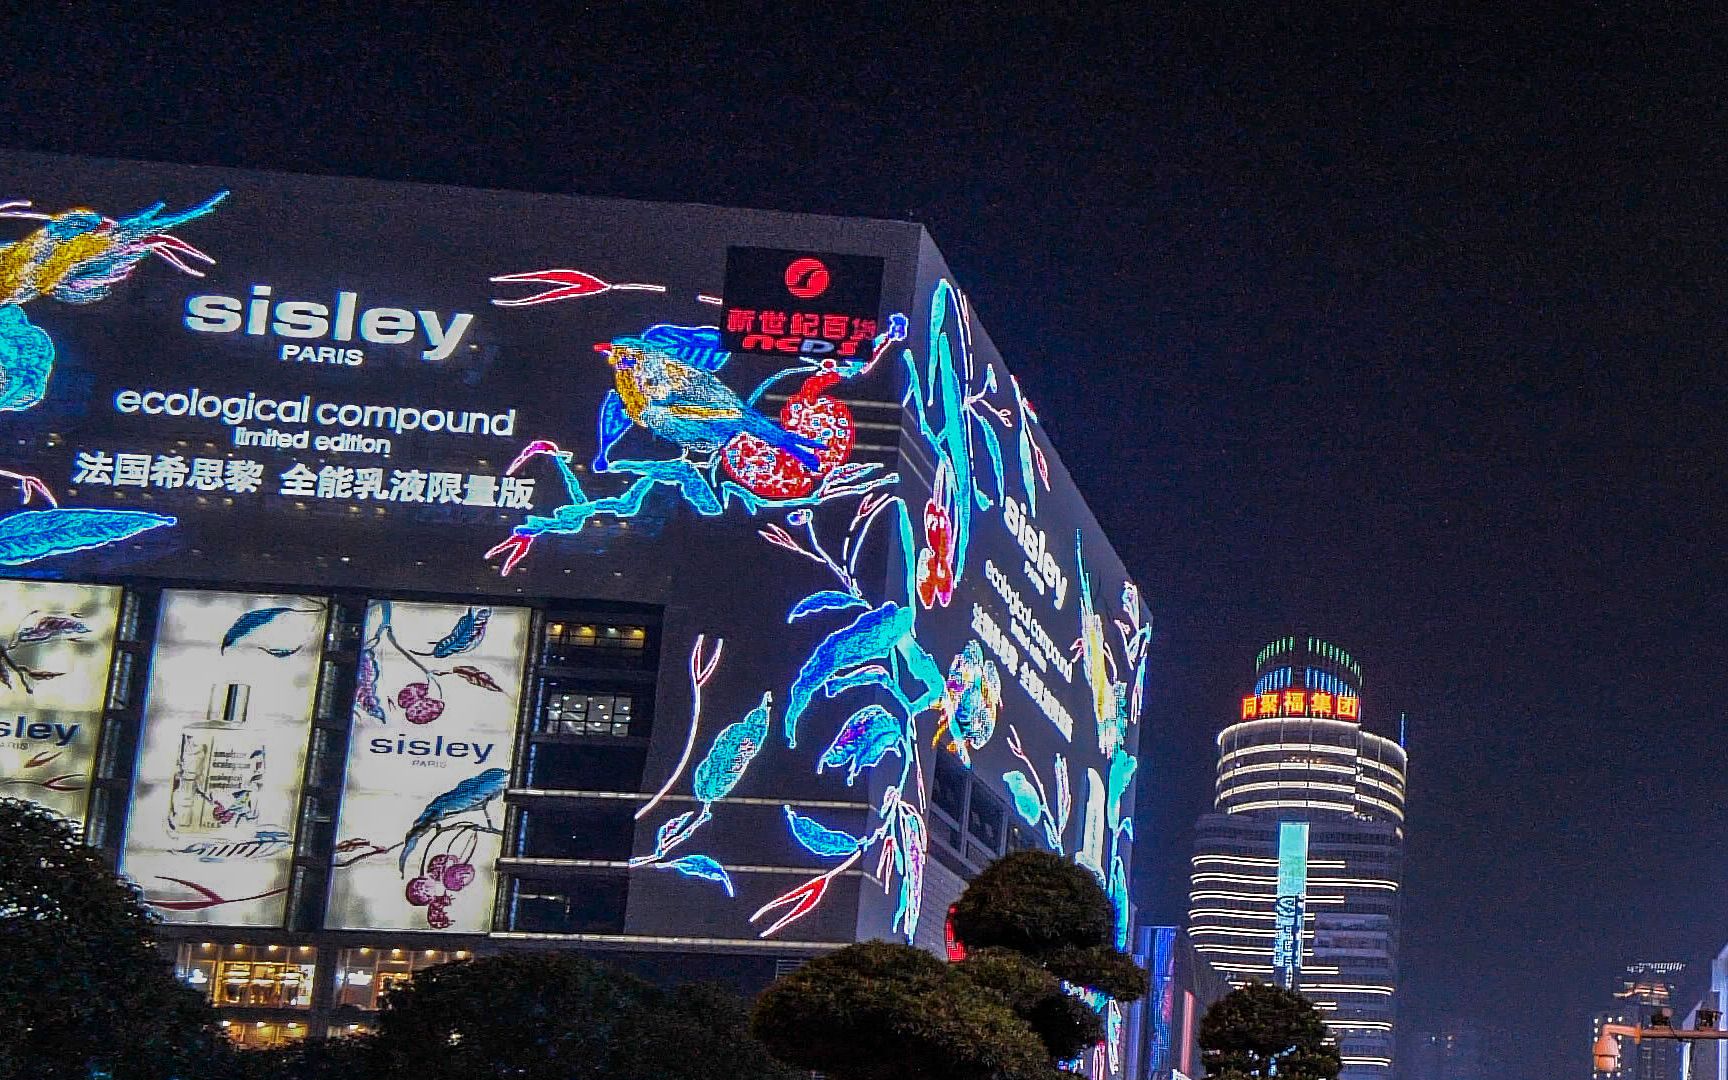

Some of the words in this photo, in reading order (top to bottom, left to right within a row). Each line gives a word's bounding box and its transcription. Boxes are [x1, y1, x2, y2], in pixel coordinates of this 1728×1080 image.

[186, 286, 472, 360] sisley
[727, 308, 877, 340] 新世纪百货
[280, 344, 364, 366] PARIS
[116, 388, 309, 425] ecological
[317, 397, 517, 437] compound
[234, 426, 310, 449] limited
[315, 433, 391, 455] edition
[74, 452, 263, 490] 法国希思黎
[280, 467, 535, 509] 全能乳液限量版
[1243, 690, 1359, 720] 同聚福集团
[369, 733, 495, 765] sisley
